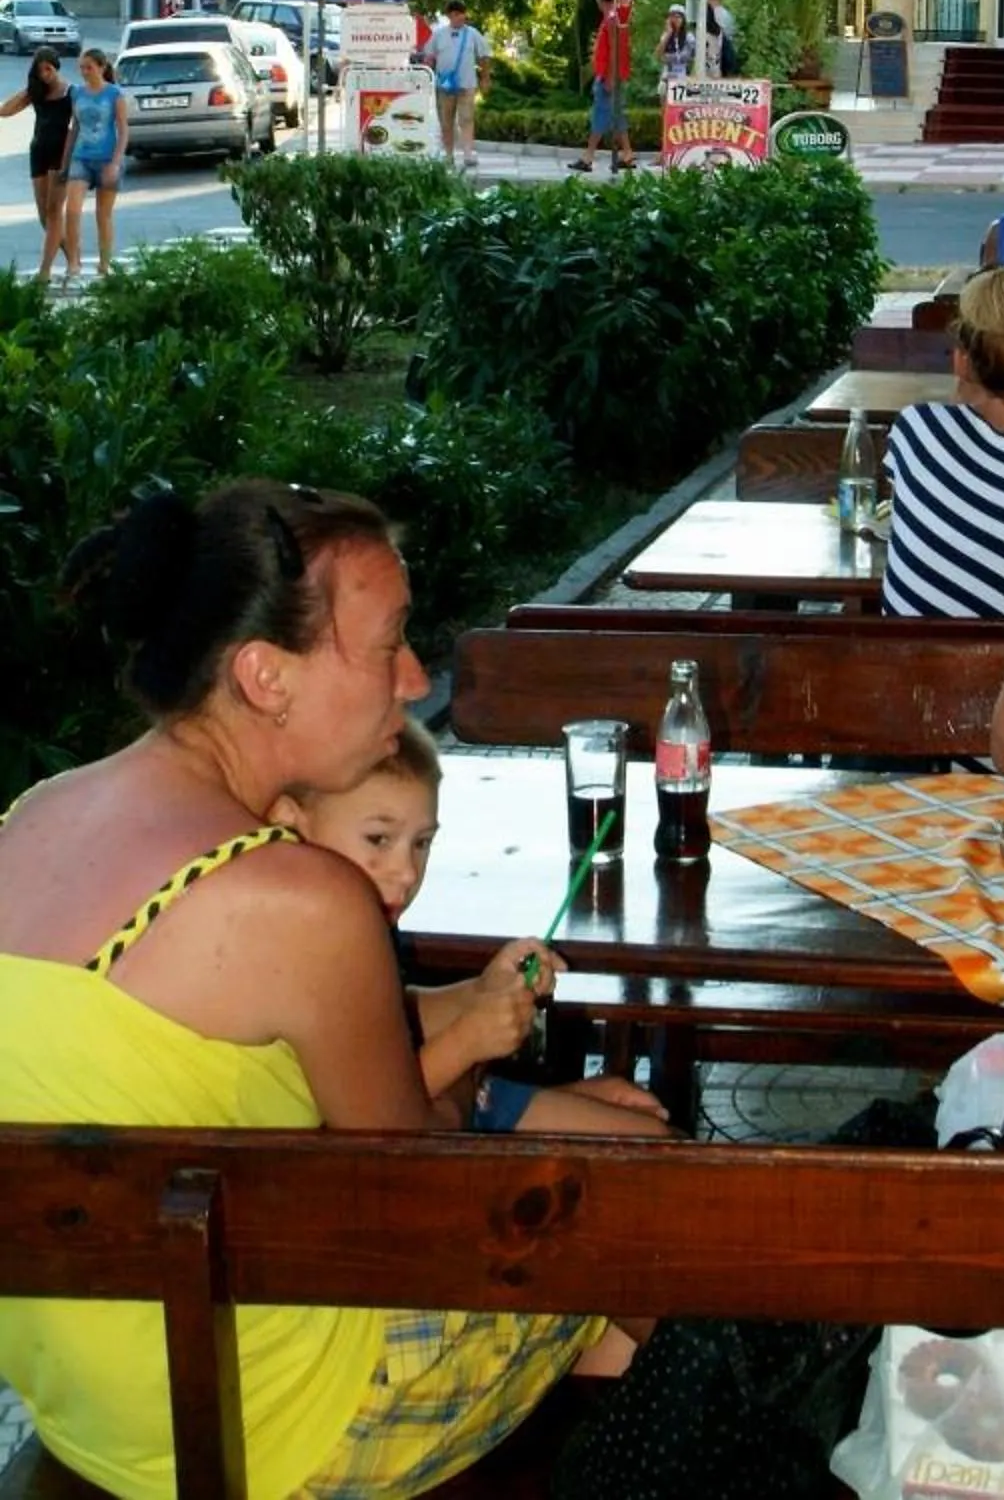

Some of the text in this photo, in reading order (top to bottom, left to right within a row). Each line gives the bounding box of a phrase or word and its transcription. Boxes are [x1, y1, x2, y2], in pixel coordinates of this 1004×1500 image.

[671, 85, 686, 101] 17
[743, 88, 760, 104] 22
[669, 119, 765, 149] ORIENT
[791, 131, 842, 147] TUBORG
